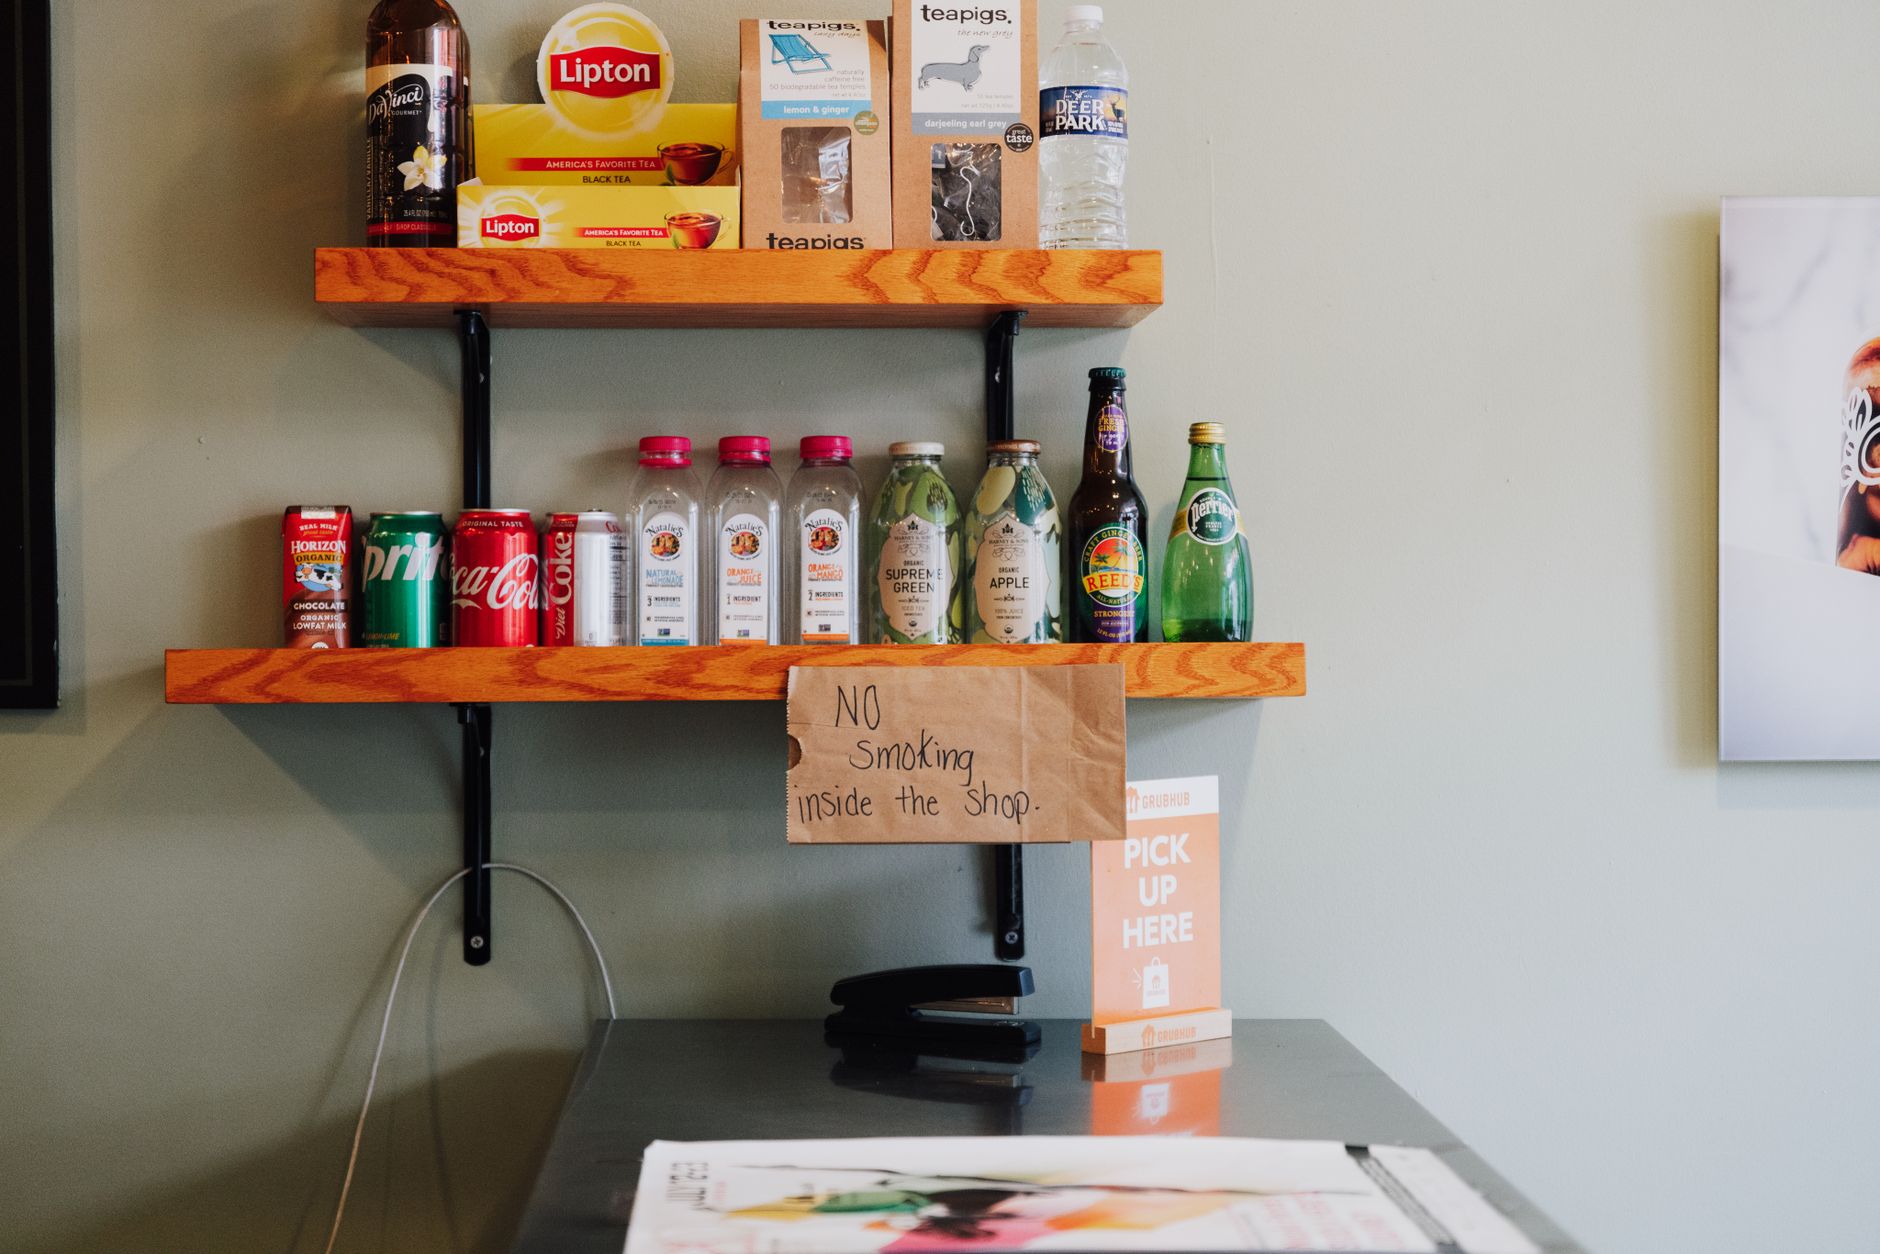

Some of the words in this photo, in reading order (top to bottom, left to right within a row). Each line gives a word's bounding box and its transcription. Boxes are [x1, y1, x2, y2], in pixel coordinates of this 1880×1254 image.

[920, 4, 1012, 25] teapigs.
[767, 20, 861, 31] teapigs.
[560, 58, 650, 88] Lipton
[368, 84, 424, 125] DaVinci
[783, 105, 811, 114] lemon
[813, 105, 820, 113] &
[821, 105, 850, 116] ginger
[1055, 99, 1105, 115] DEER
[924, 120, 967, 129] darjeeling
[988, 121, 1007, 129] grey
[1055, 114, 1107, 133] PARK
[1005, 135, 1032, 143] taste
[546, 160, 593, 168] AMERICA'S
[595, 160, 637, 168] FAVORITE
[582, 175, 611, 183] BLACK
[614, 175, 631, 183] TEA
[485, 220, 535, 235] Lipton
[766, 232, 865, 249] teapigs
[805, 517, 844, 532] Natalie's
[1191, 500, 1233, 533] Perrier
[645, 523, 684, 538] Natalie's
[725, 523, 764, 538] Natalie's
[1101, 530, 1129, 540] GINGE
[291, 540, 346, 554] HORIZON
[296, 553, 343, 563] ORGANIC
[362, 531, 449, 593] prit
[550, 532, 572, 605] Coke
[886, 569, 943, 580] SUPREME
[450, 553, 538, 611] ca-Col
[738, 574, 762, 586] JUICE
[893, 582, 935, 593] GREEN
[989, 577, 1030, 588] APPLE
[1086, 573, 1141, 592] REEDS
[293, 602, 345, 610] CHOCOLATE
[293, 622, 326, 630] LOWFAT
[327, 622, 347, 630] MILK
[556, 607, 566, 639] Diet
[835, 685, 881, 730] NO
[849, 729, 975, 787] Smoking
[793, 785, 873, 824] inside
[895, 785, 939, 816] the
[1142, 792, 1190, 809] GRUBHUB
[1124, 833, 1191, 869] PICK
[1139, 874, 1178, 907] UP
[1123, 911, 1193, 949] HERE
[1157, 1026, 1197, 1043] GRUBHUB
